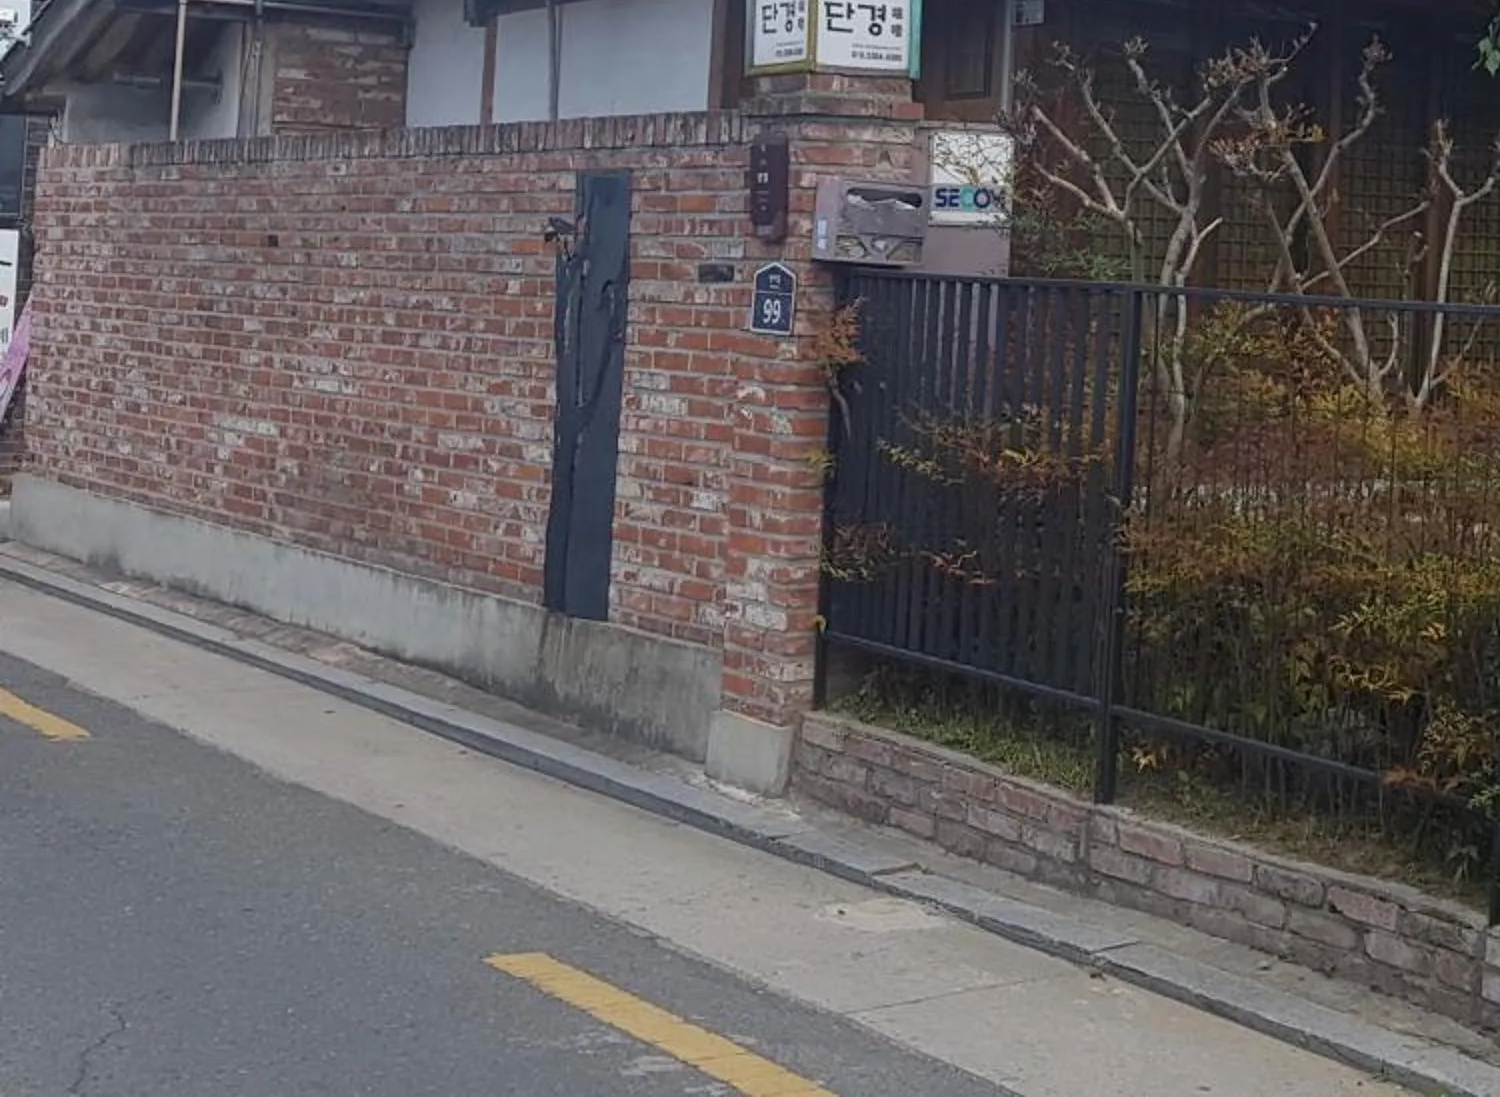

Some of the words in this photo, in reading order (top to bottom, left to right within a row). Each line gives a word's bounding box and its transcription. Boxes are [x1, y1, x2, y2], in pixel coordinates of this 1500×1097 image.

[762, 1, 795, 34] 단경
[824, 1, 887, 36] 단경
[763, 299, 781, 324] 99
